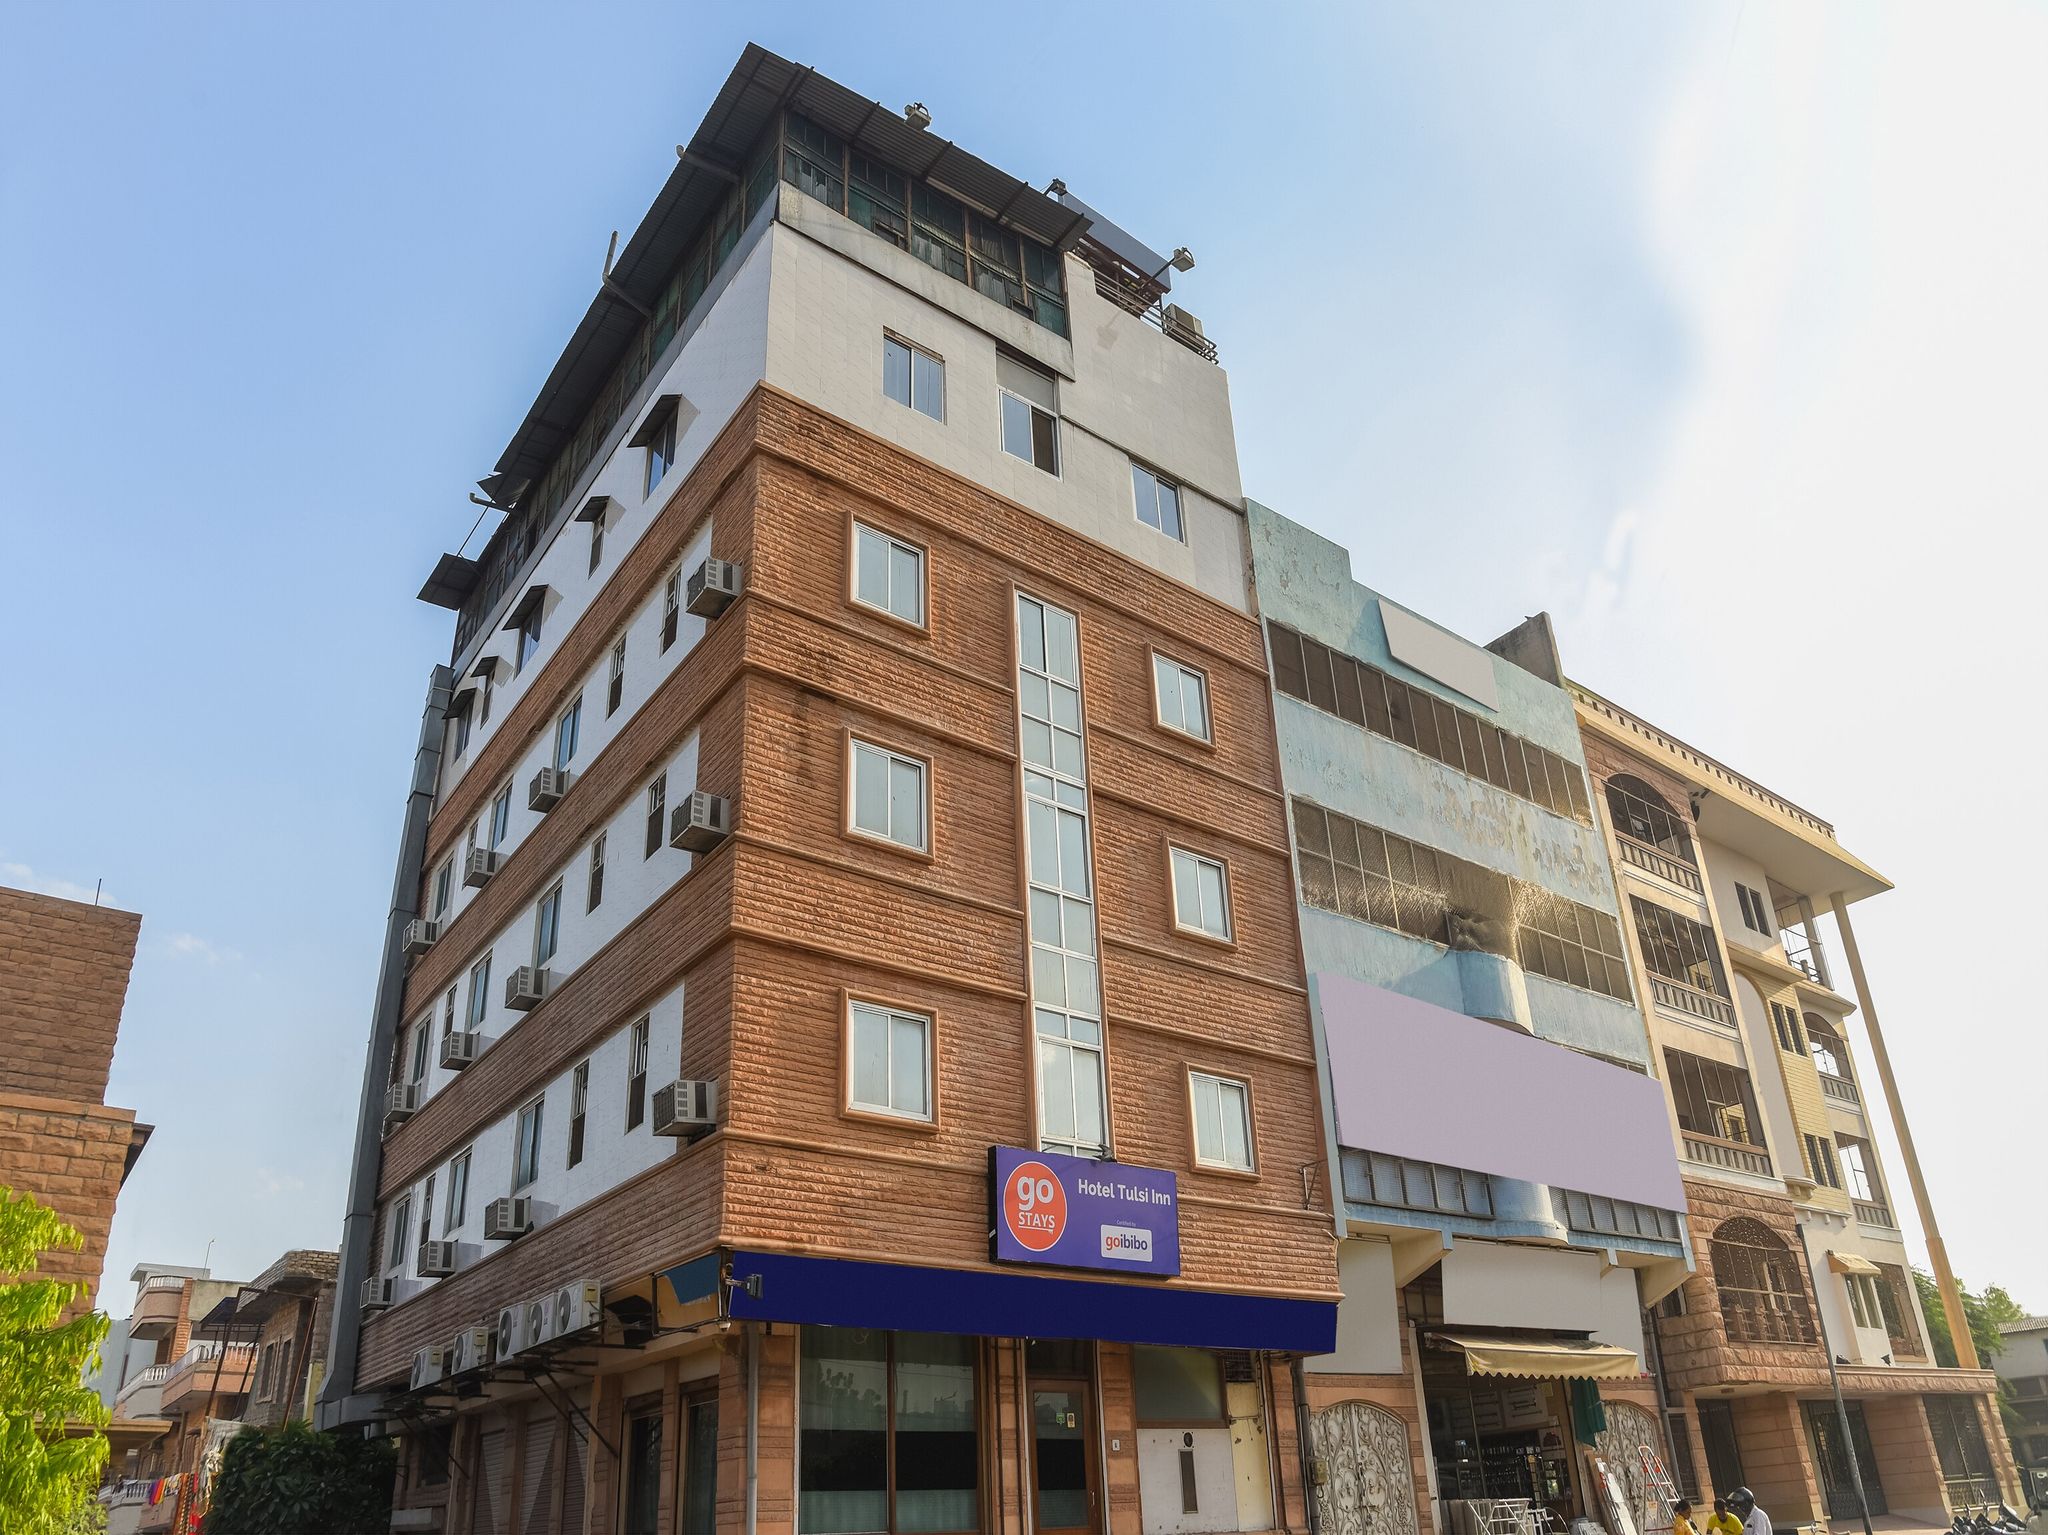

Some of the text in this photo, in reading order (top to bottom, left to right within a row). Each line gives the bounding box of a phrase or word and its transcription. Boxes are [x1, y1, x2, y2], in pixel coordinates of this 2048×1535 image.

[1017, 1176, 1054, 1211] go
[1078, 1178, 1171, 1206] Hotel Tulsi Inn
[1018, 1211, 1055, 1229] STAYS
[1105, 1233, 1148, 1250] goibibo
